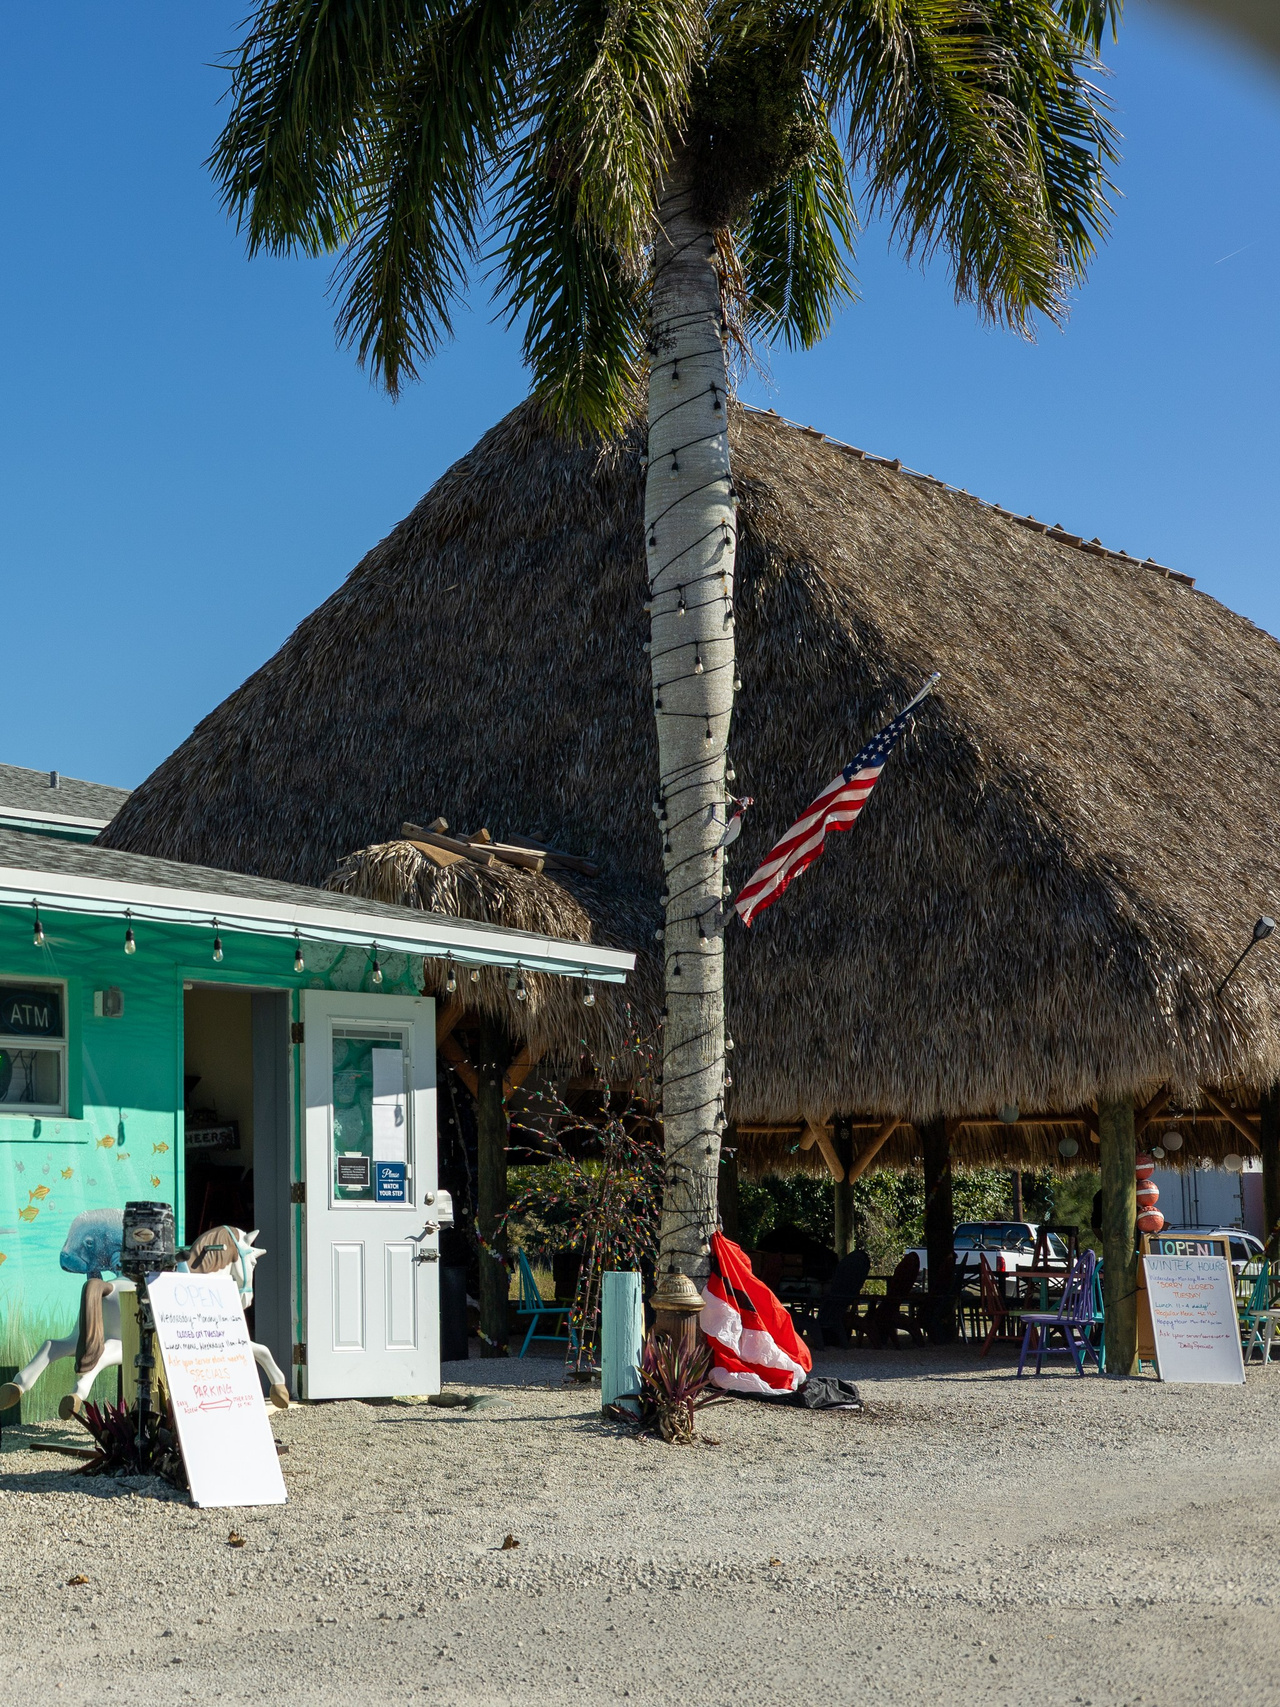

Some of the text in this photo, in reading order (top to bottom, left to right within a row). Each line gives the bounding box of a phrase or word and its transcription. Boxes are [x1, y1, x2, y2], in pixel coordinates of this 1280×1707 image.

[10, 1003, 49, 1028] ATM
[185, 1131, 227, 1145] HEERS
[381, 1168, 400, 1179] Please
[1164, 1241, 1209, 1256] OPEN
[1198, 1260, 1226, 1272] HOURS
[174, 1283, 224, 1309] OPEN
[1172, 1291, 1202, 1299] TUESDAY
[189, 1367, 231, 1382] SPECIALS
[193, 1383, 234, 1399] PARKING
